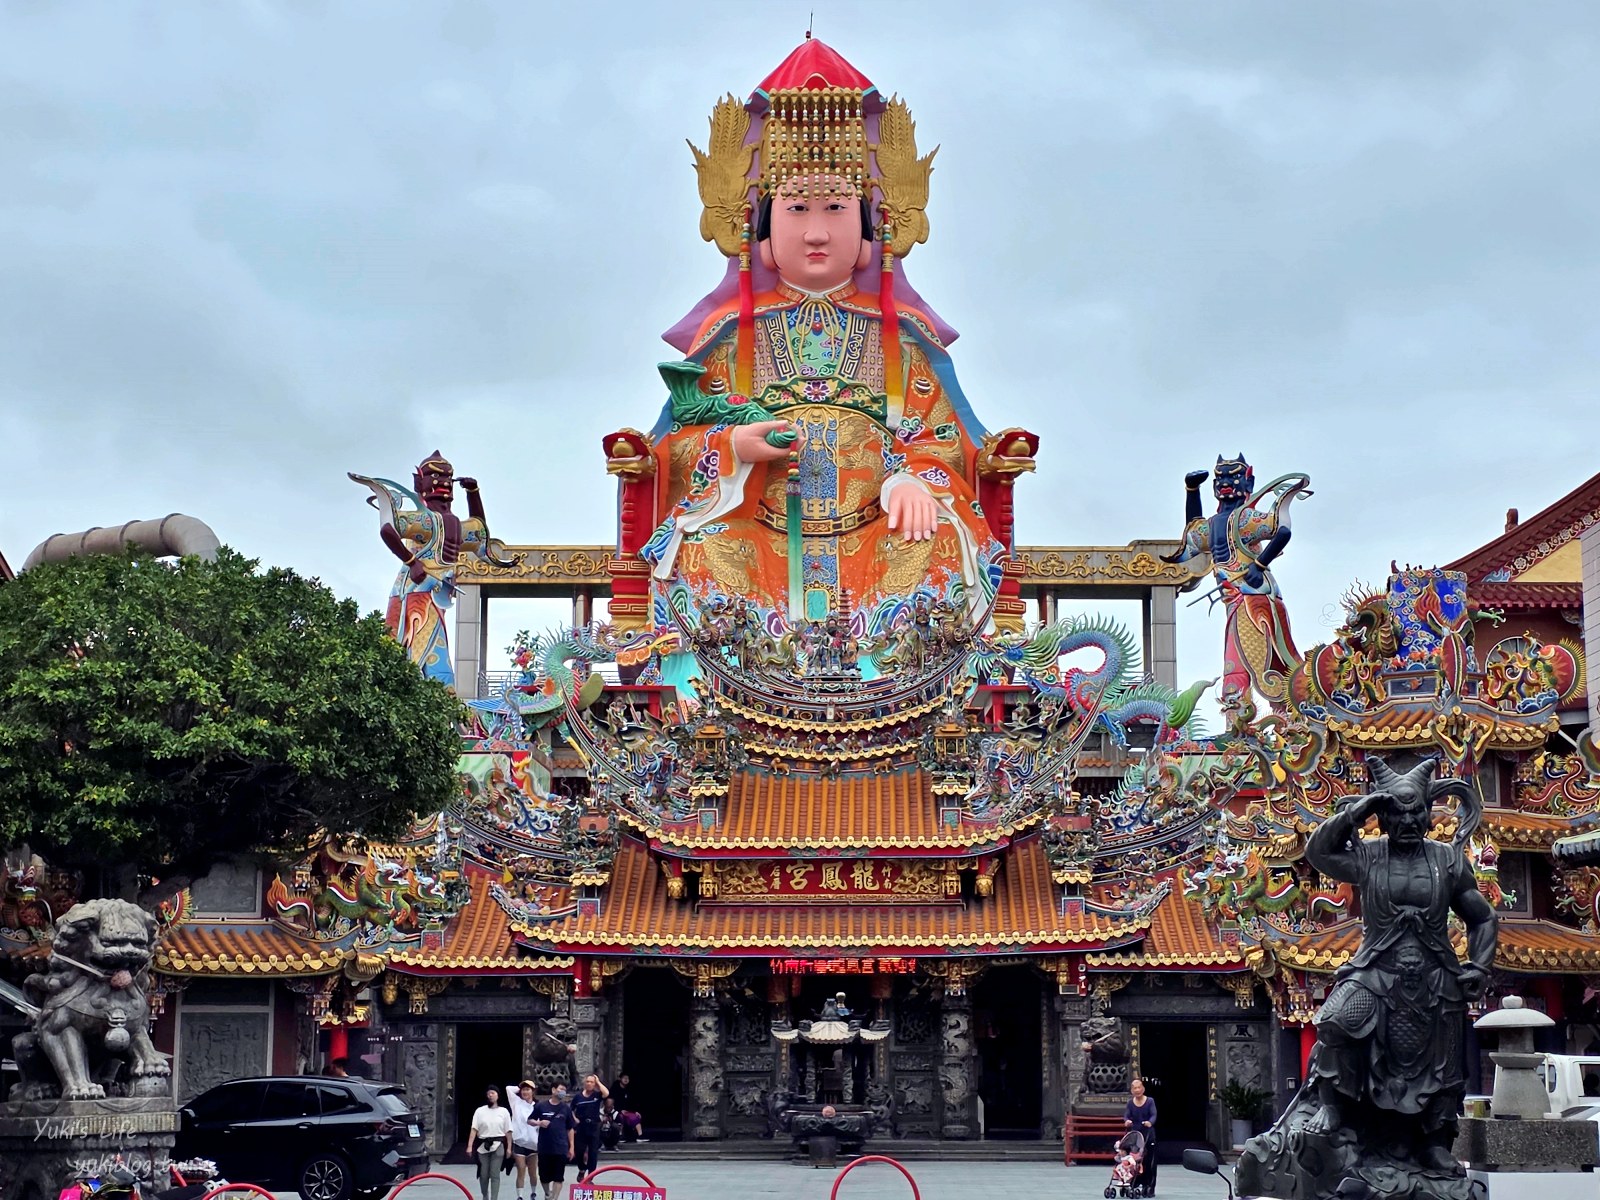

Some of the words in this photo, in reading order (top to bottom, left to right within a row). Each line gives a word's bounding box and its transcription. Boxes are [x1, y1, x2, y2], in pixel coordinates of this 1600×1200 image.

[786, 860, 880, 891] 龍鳳宮
[881, 864, 892, 889] 竹南
